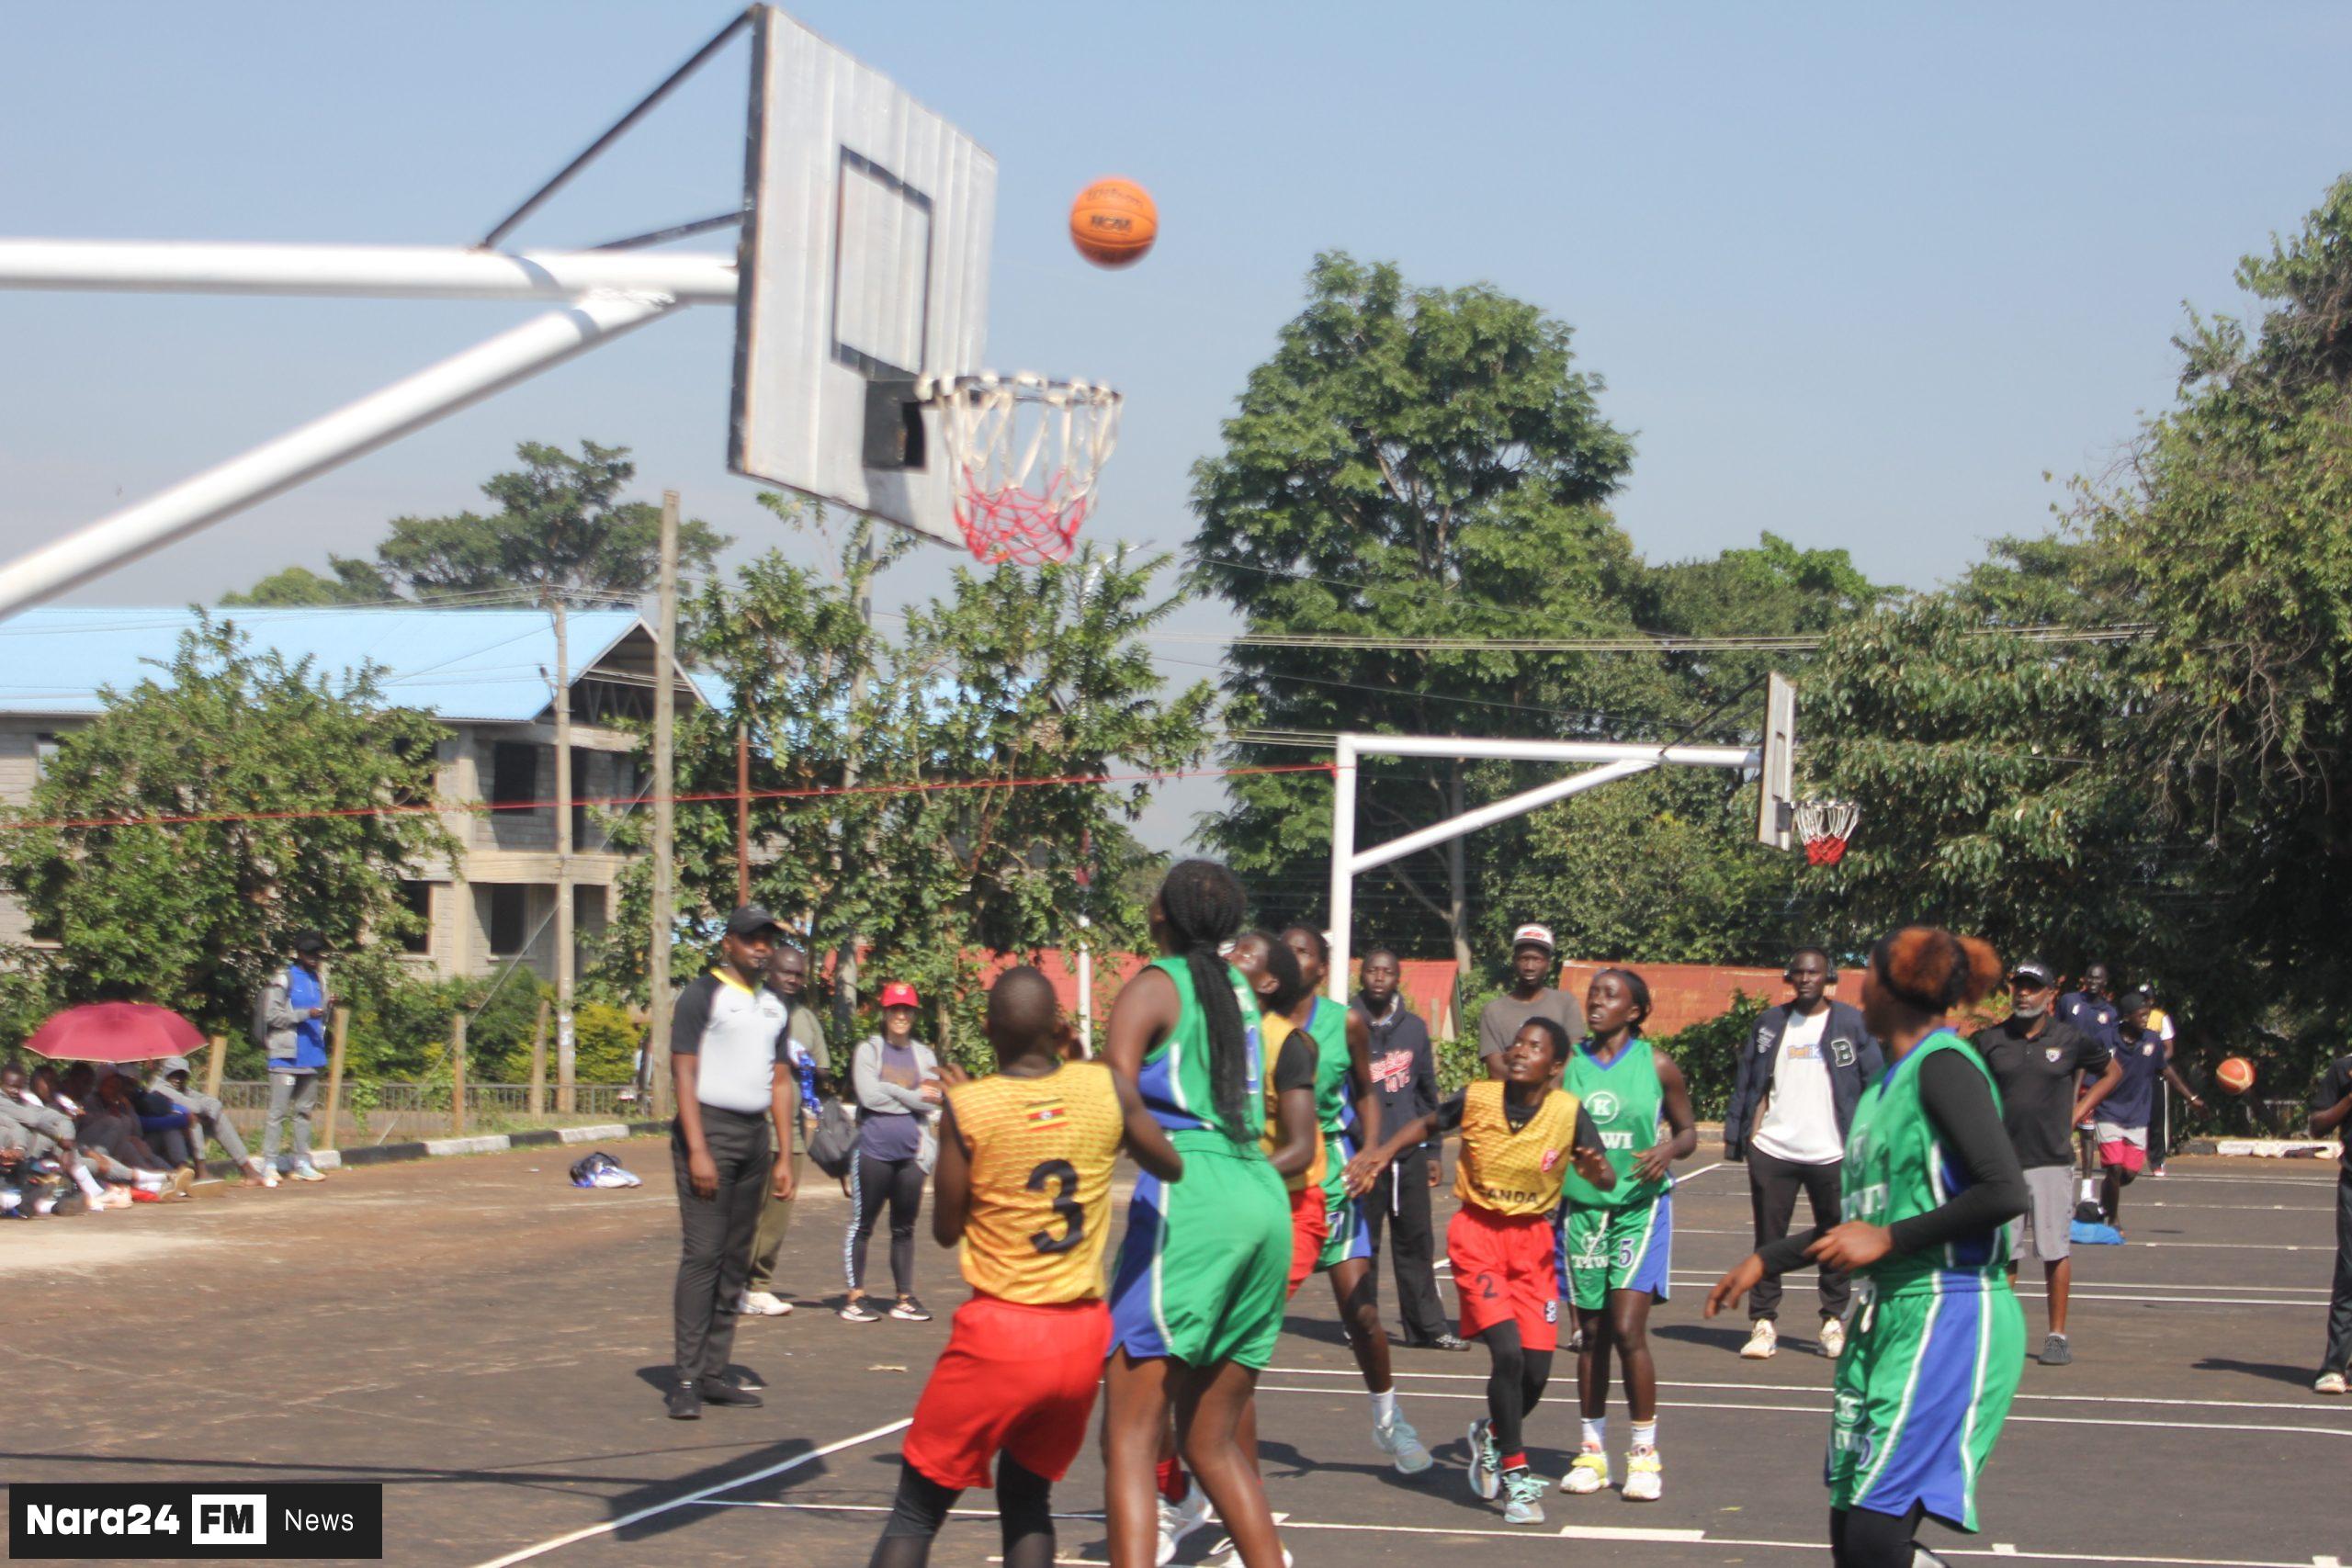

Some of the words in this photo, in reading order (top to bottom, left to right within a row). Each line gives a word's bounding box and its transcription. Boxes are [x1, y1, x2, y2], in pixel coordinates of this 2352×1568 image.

[1787, 1043, 1822, 1060] Betik
[1591, 1099, 1611, 1116] K
[1599, 1132, 1634, 1150] WI
[1026, 1158, 1085, 1254] 3
[1618, 1237, 1634, 1268] 5
[1475, 1273, 1499, 1299] 2
